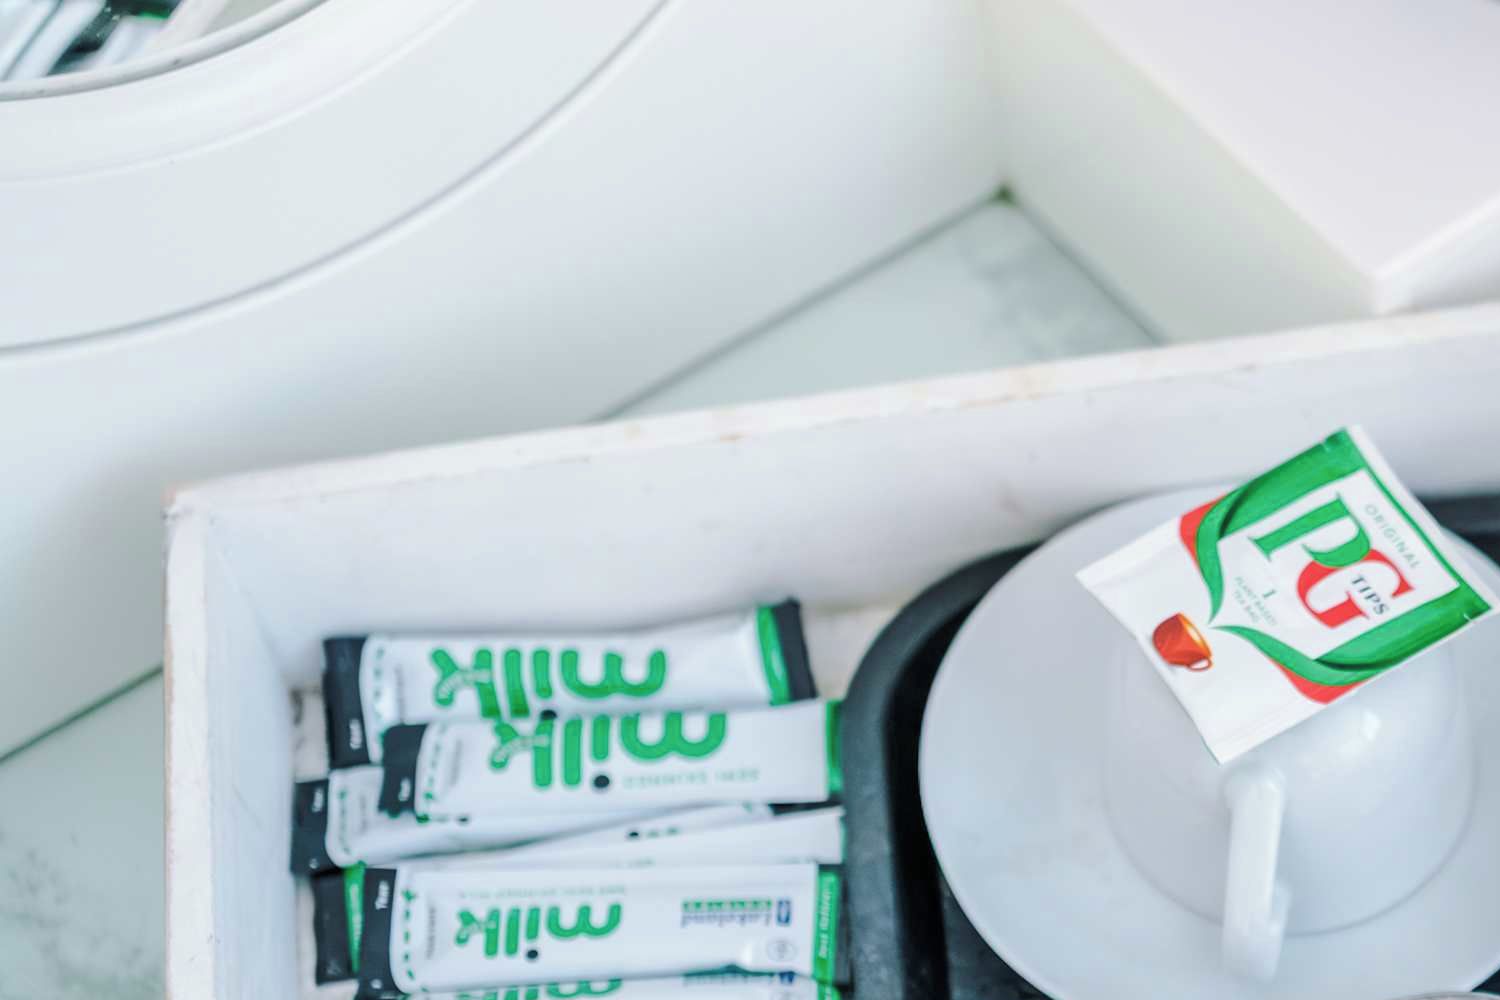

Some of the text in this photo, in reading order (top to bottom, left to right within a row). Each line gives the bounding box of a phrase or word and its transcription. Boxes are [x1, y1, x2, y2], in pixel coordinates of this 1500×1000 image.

[1248, 493, 1415, 629] PG
[1366, 504, 1420, 570] ORIGINAL
[1350, 576, 1389, 616] TIPS
[431, 648, 666, 720] milk
[490, 711, 727, 789] milk
[455, 902, 623, 961] milk
